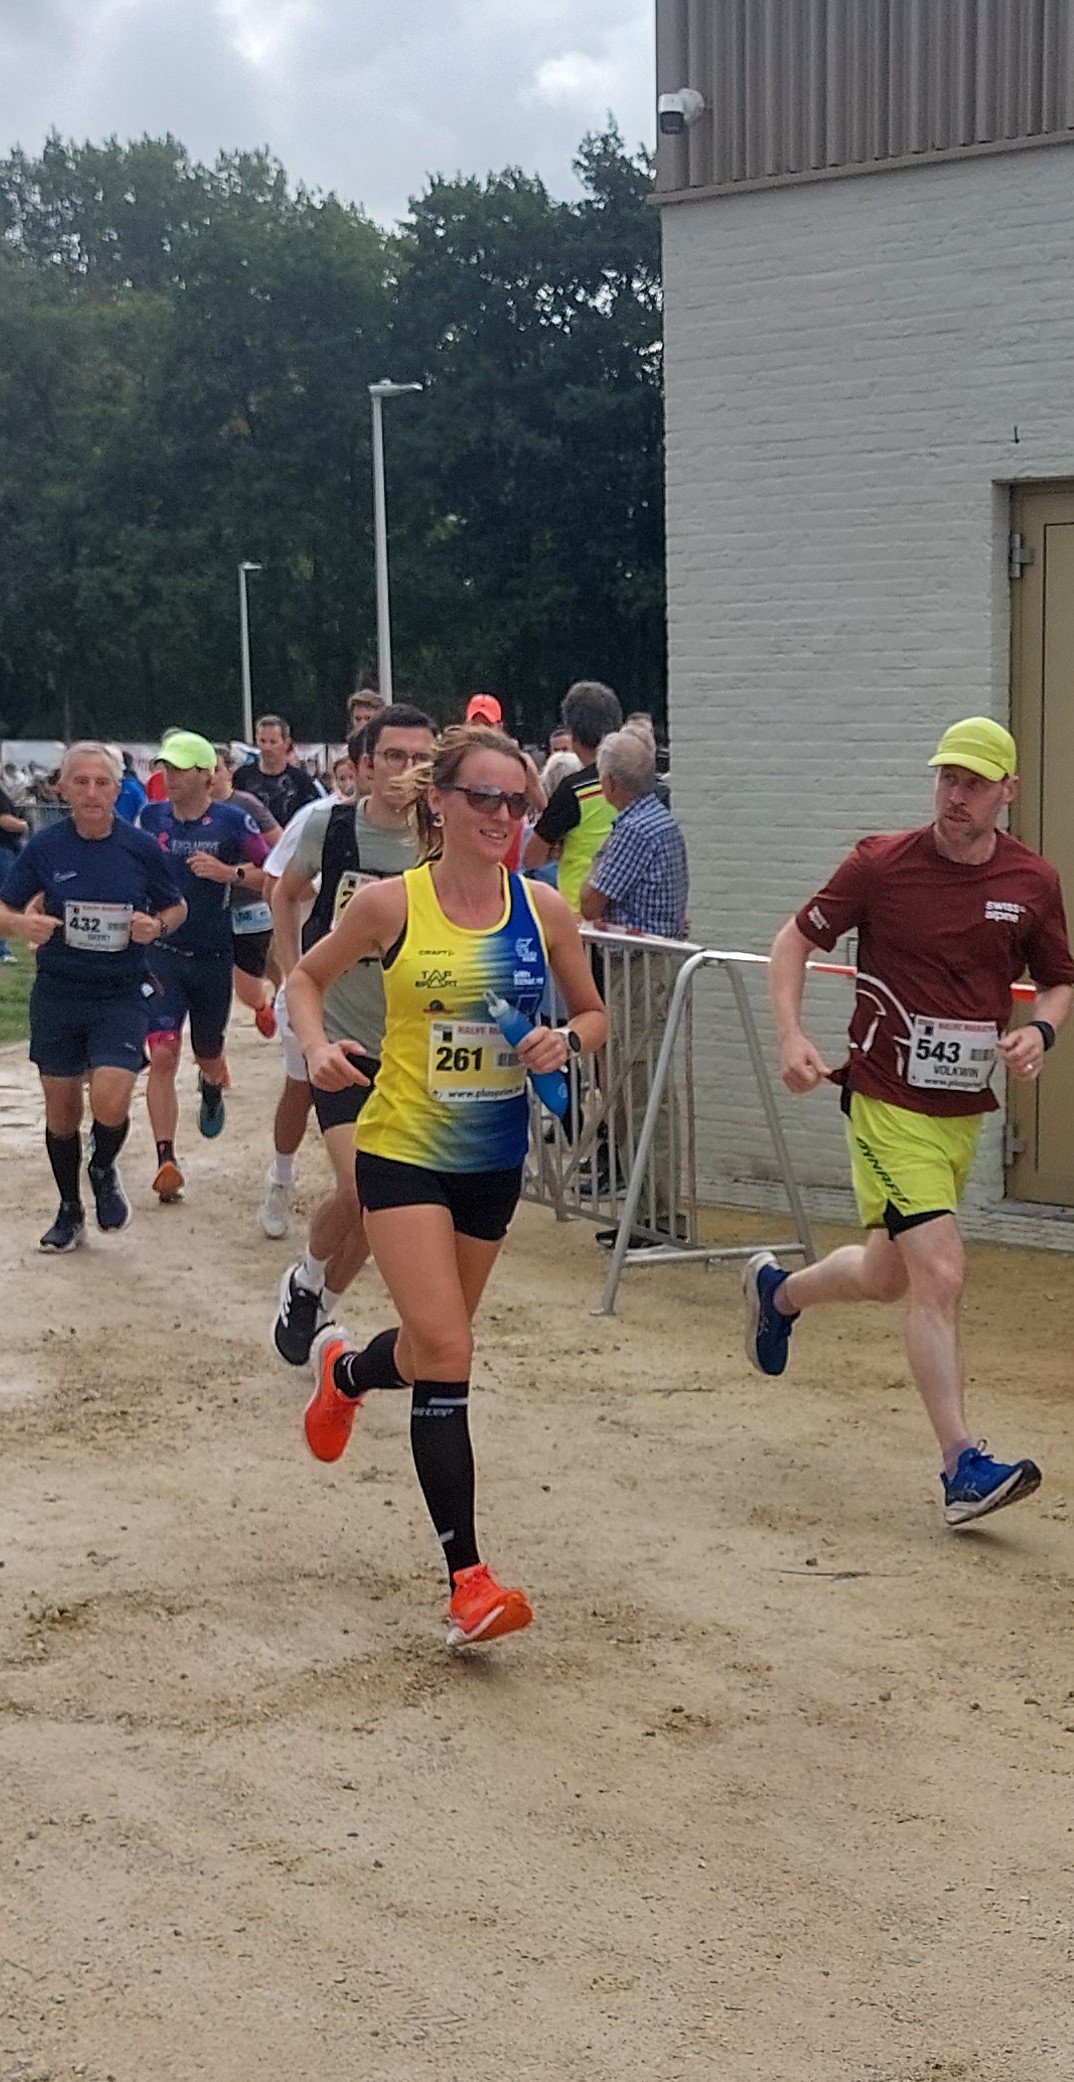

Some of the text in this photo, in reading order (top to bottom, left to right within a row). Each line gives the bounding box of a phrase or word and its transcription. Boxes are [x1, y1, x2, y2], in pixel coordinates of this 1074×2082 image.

[69, 917, 101, 932] 432
[436, 1046, 483, 1071] 261
[916, 1039, 961, 1063] 543
